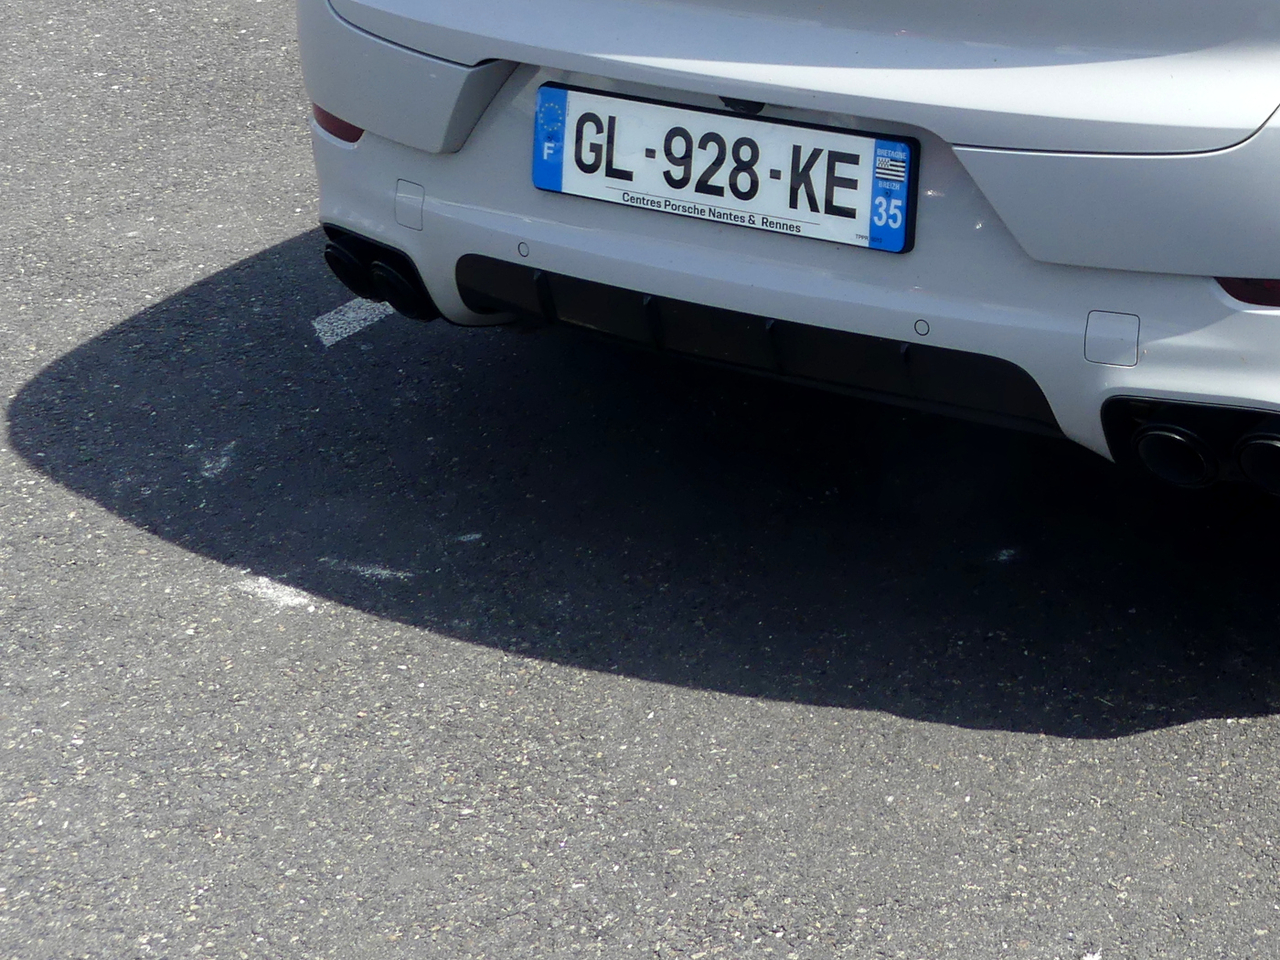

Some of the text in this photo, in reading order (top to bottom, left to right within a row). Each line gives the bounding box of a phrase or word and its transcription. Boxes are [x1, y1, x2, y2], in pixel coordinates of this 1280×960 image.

[543, 141, 555, 160] F
[876, 148, 907, 159] BRETAGNE
[573, 111, 860, 220] GL-928-KE
[878, 181, 900, 190] BREIZH
[622, 192, 801, 233] Centres Porsche Nantes & Rennes
[873, 196, 902, 229] 35
